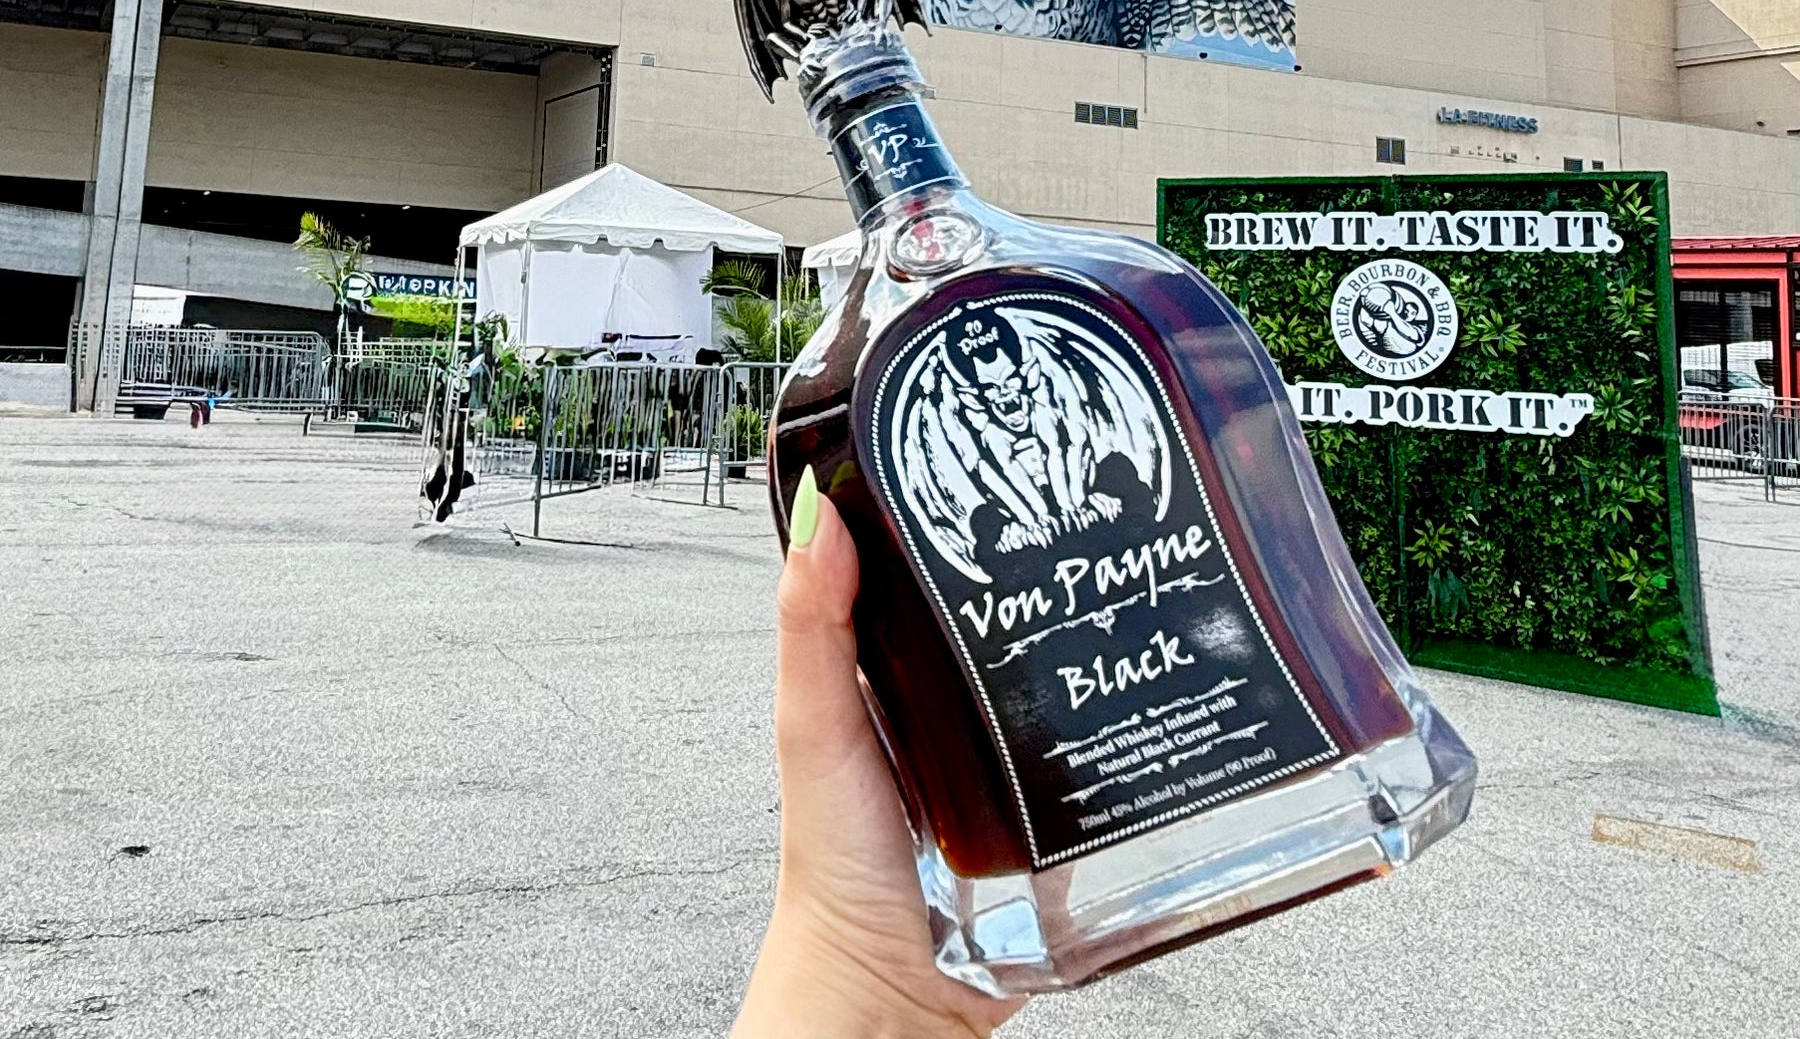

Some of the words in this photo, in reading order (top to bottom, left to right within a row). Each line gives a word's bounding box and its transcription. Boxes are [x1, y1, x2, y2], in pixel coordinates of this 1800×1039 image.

[868, 134, 907, 164] VP
[1208, 217, 1318, 246] BREW
[1331, 217, 1385, 247] IT.
[1400, 216, 1539, 247] TASTE
[1553, 216, 1618, 248] IT.
[1348, 264, 1430, 293] BOURBON
[1427, 286, 1440, 299] &
[1435, 300, 1452, 336] BBQ
[957, 326, 999, 356] Proof
[965, 319, 983, 337] 90
[1300, 387, 1353, 419] IT.
[1369, 390, 1492, 427] PORK
[959, 590, 1052, 639] Von
[1053, 525, 1211, 616] Payne
[1057, 629, 1195, 710] Black
[1066, 739, 1115, 768] Blended
[1113, 723, 1164, 750] Whiskey
[1163, 707, 1210, 732] Infused
[1209, 694, 1237, 714] with
[1097, 749, 1143, 776] Natural
[1141, 737, 1175, 759] Black
[1174, 720, 1221, 747] Currant
